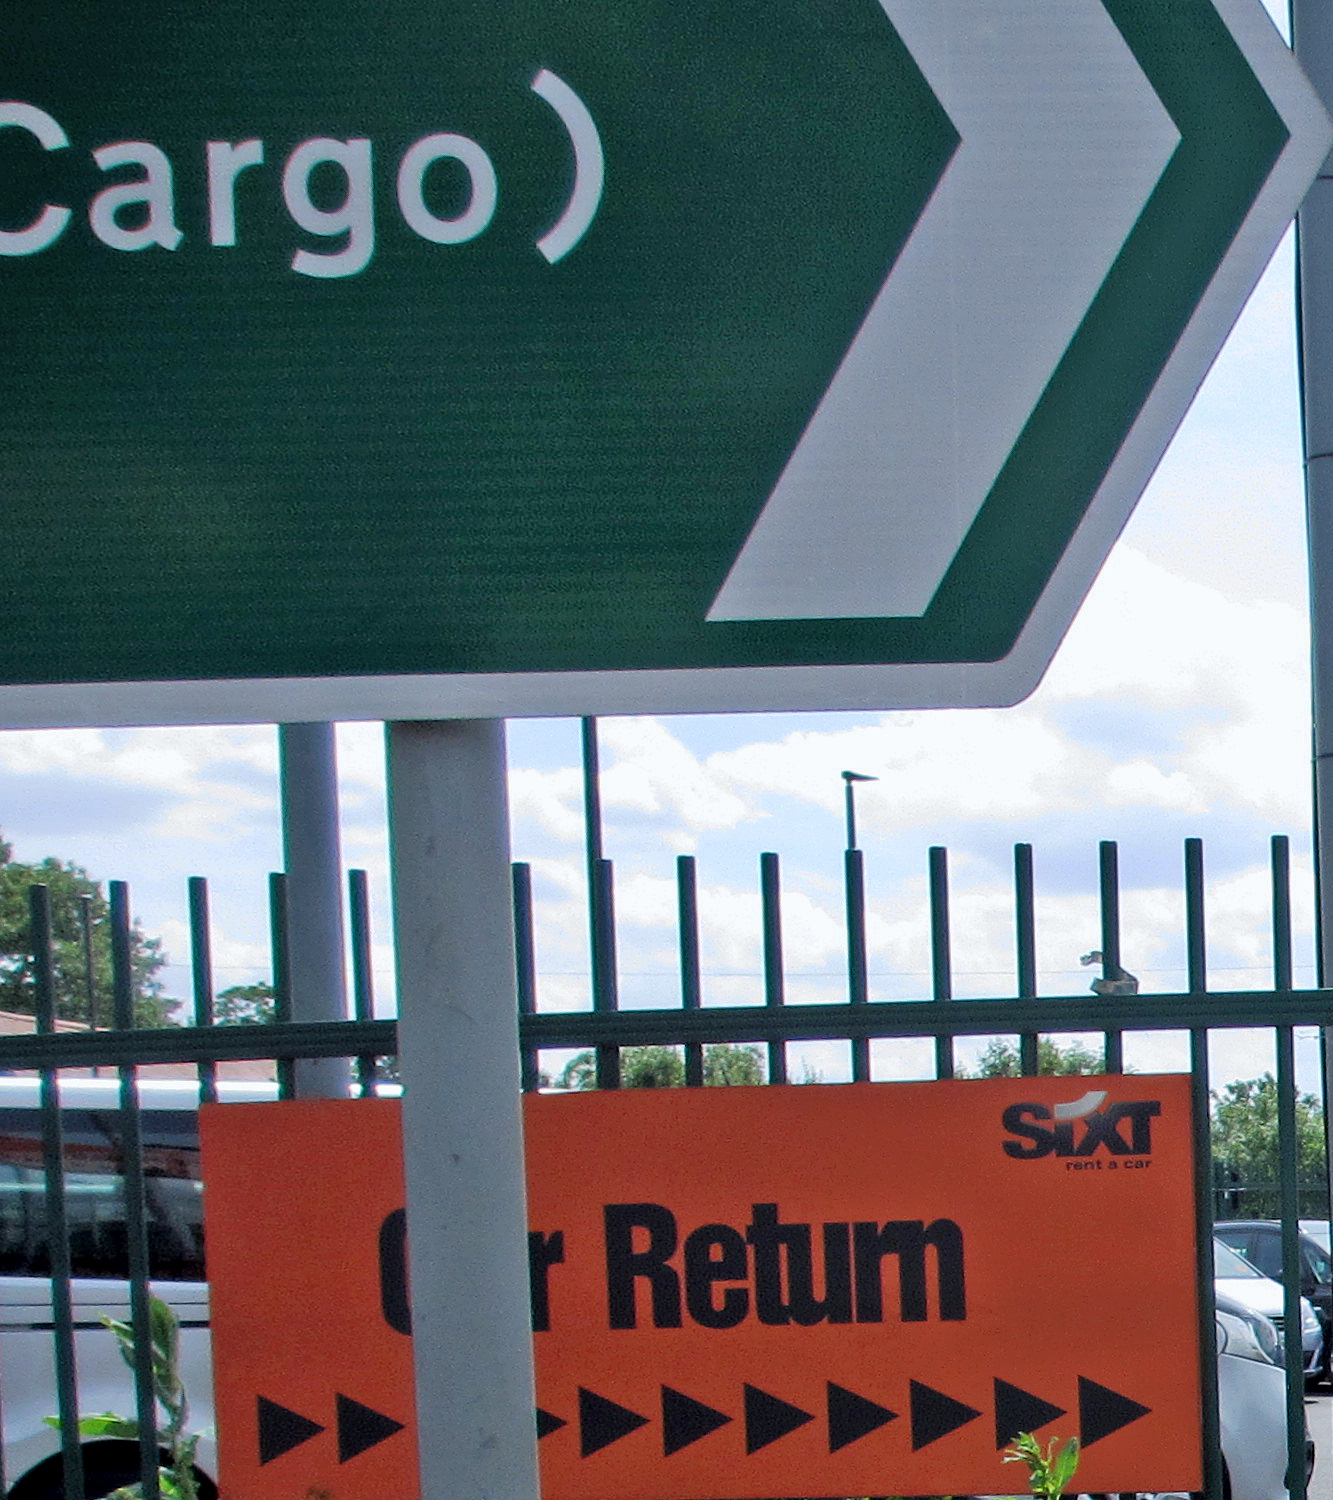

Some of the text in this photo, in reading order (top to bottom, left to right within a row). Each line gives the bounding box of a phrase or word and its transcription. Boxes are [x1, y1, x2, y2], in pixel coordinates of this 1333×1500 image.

[1066, 1159, 1152, 1171] rent a car
[603, 1202, 967, 1330] Return
